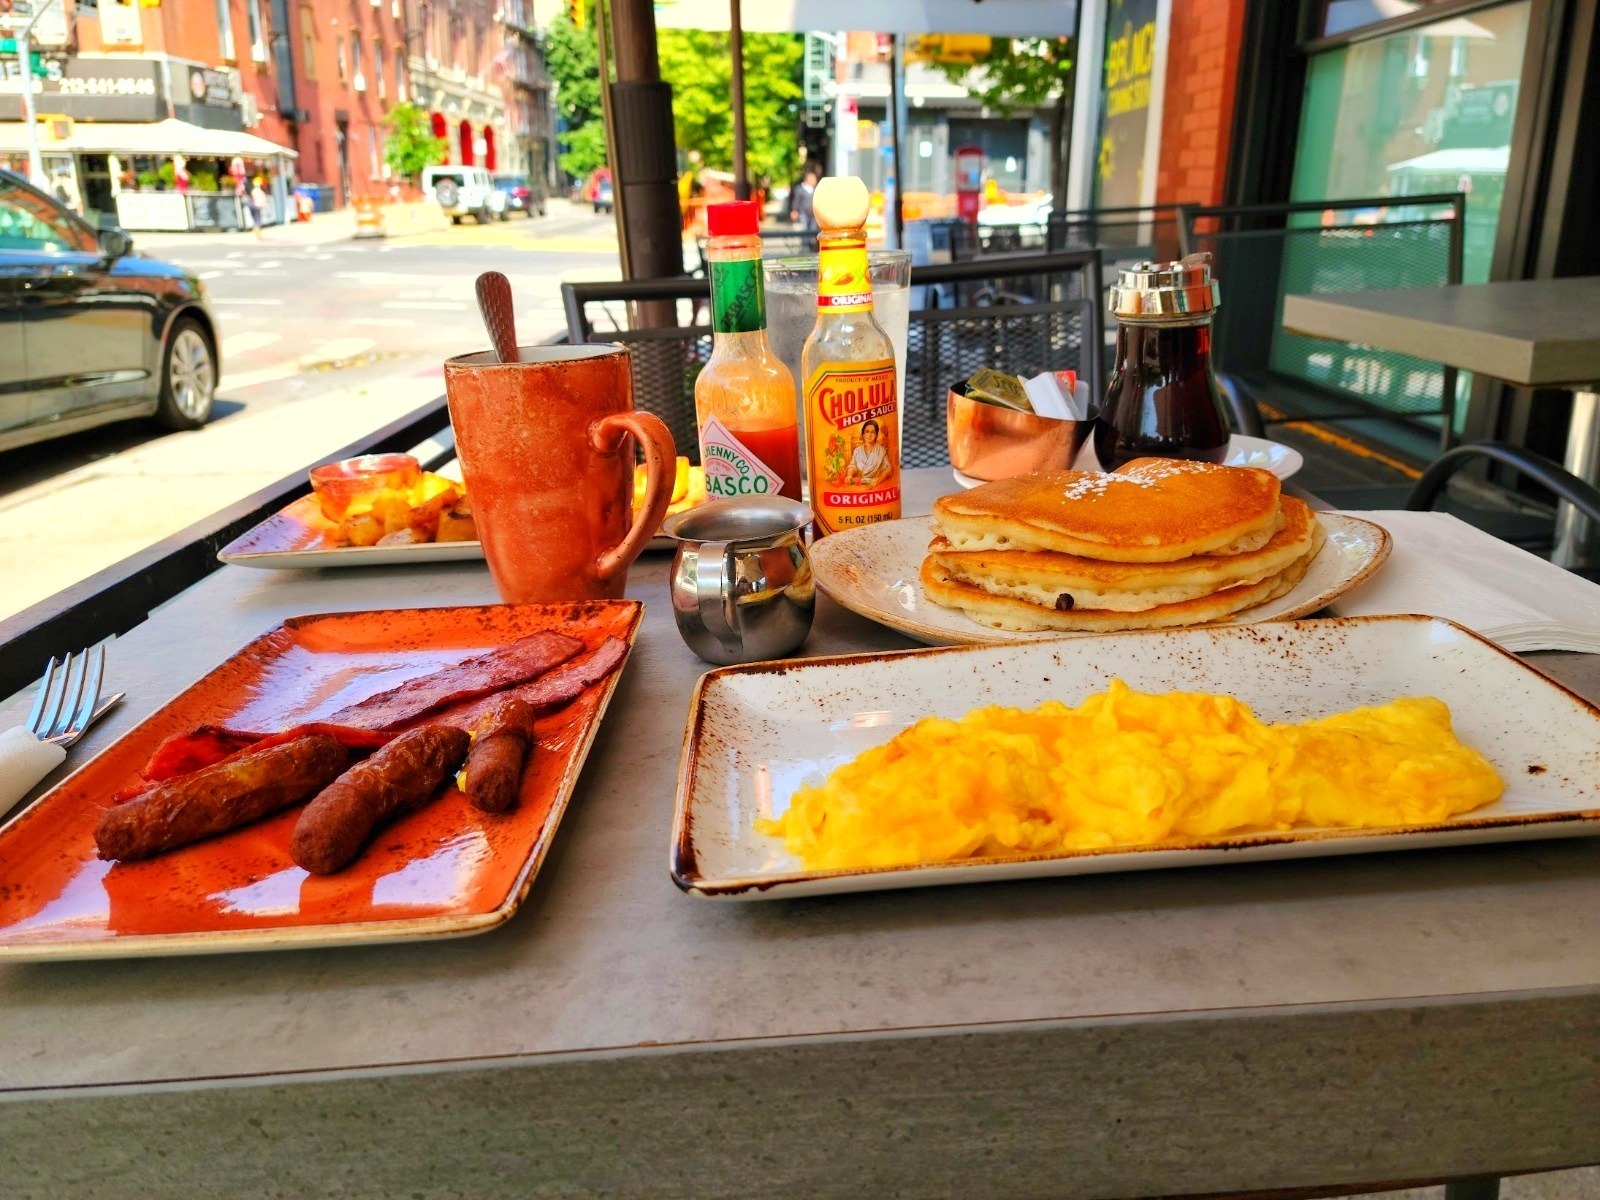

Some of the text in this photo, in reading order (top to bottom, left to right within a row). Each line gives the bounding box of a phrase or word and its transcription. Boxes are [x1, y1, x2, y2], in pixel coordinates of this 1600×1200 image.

[842, 403, 895, 427] HOT SAUCE
[829, 488, 897, 505] ORIGINAL
[838, 516, 844, 524] 5
[845, 515, 854, 524] FL
[855, 516, 866, 524] OZ
[867, 513, 882, 523] (150
